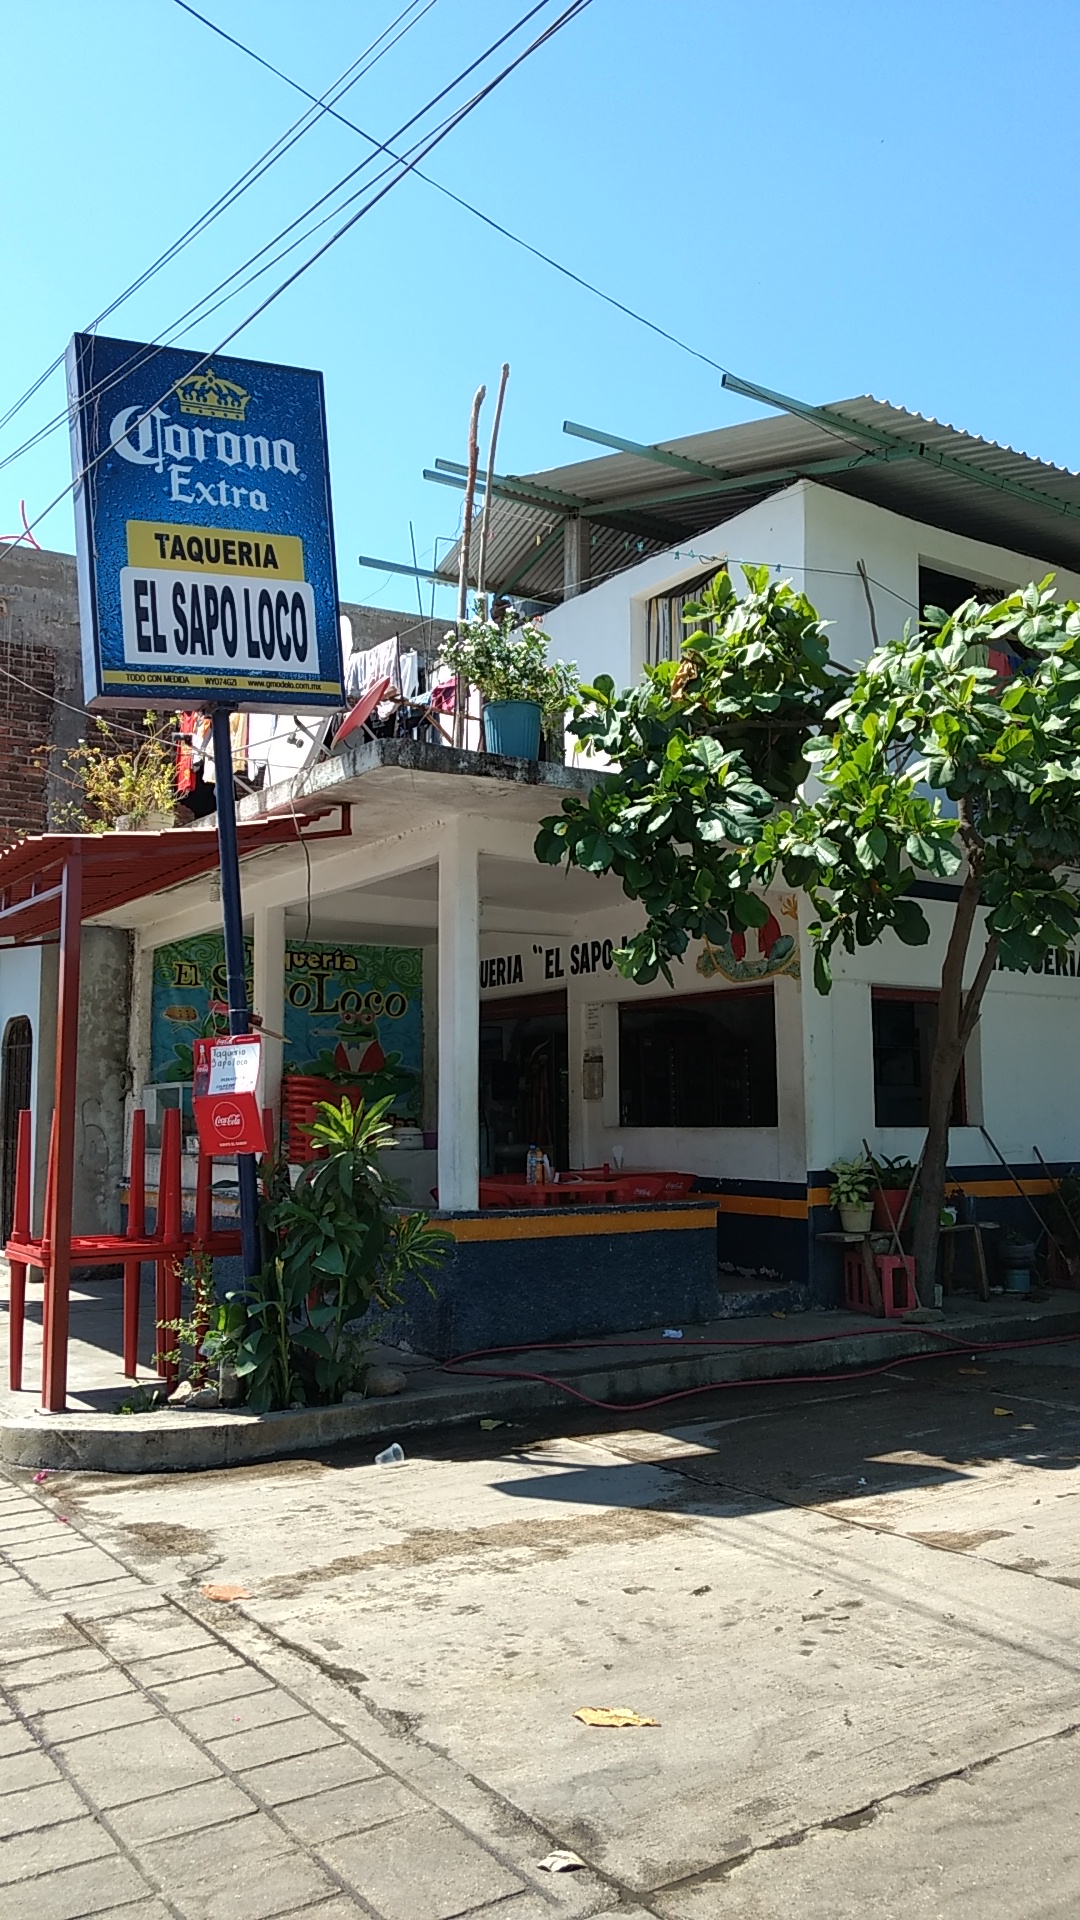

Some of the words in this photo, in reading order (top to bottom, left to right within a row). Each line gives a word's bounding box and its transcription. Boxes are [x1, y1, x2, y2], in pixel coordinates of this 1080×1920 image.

[110, 404, 301, 476] Corona
[167, 463, 270, 512] Extra
[154, 532, 279, 570] TAQUERIA
[133, 578, 168, 654] EL
[173, 581, 238, 660] SAPO
[243, 587, 308, 664] LOCO
[125, 673, 146, 682] TODO
[147, 674, 163, 683] CON
[163, 675, 190, 684] MEDIDA
[247, 680, 322, 691] www.gmodelo.com.mx
[570, 938, 614, 975] SAPO
